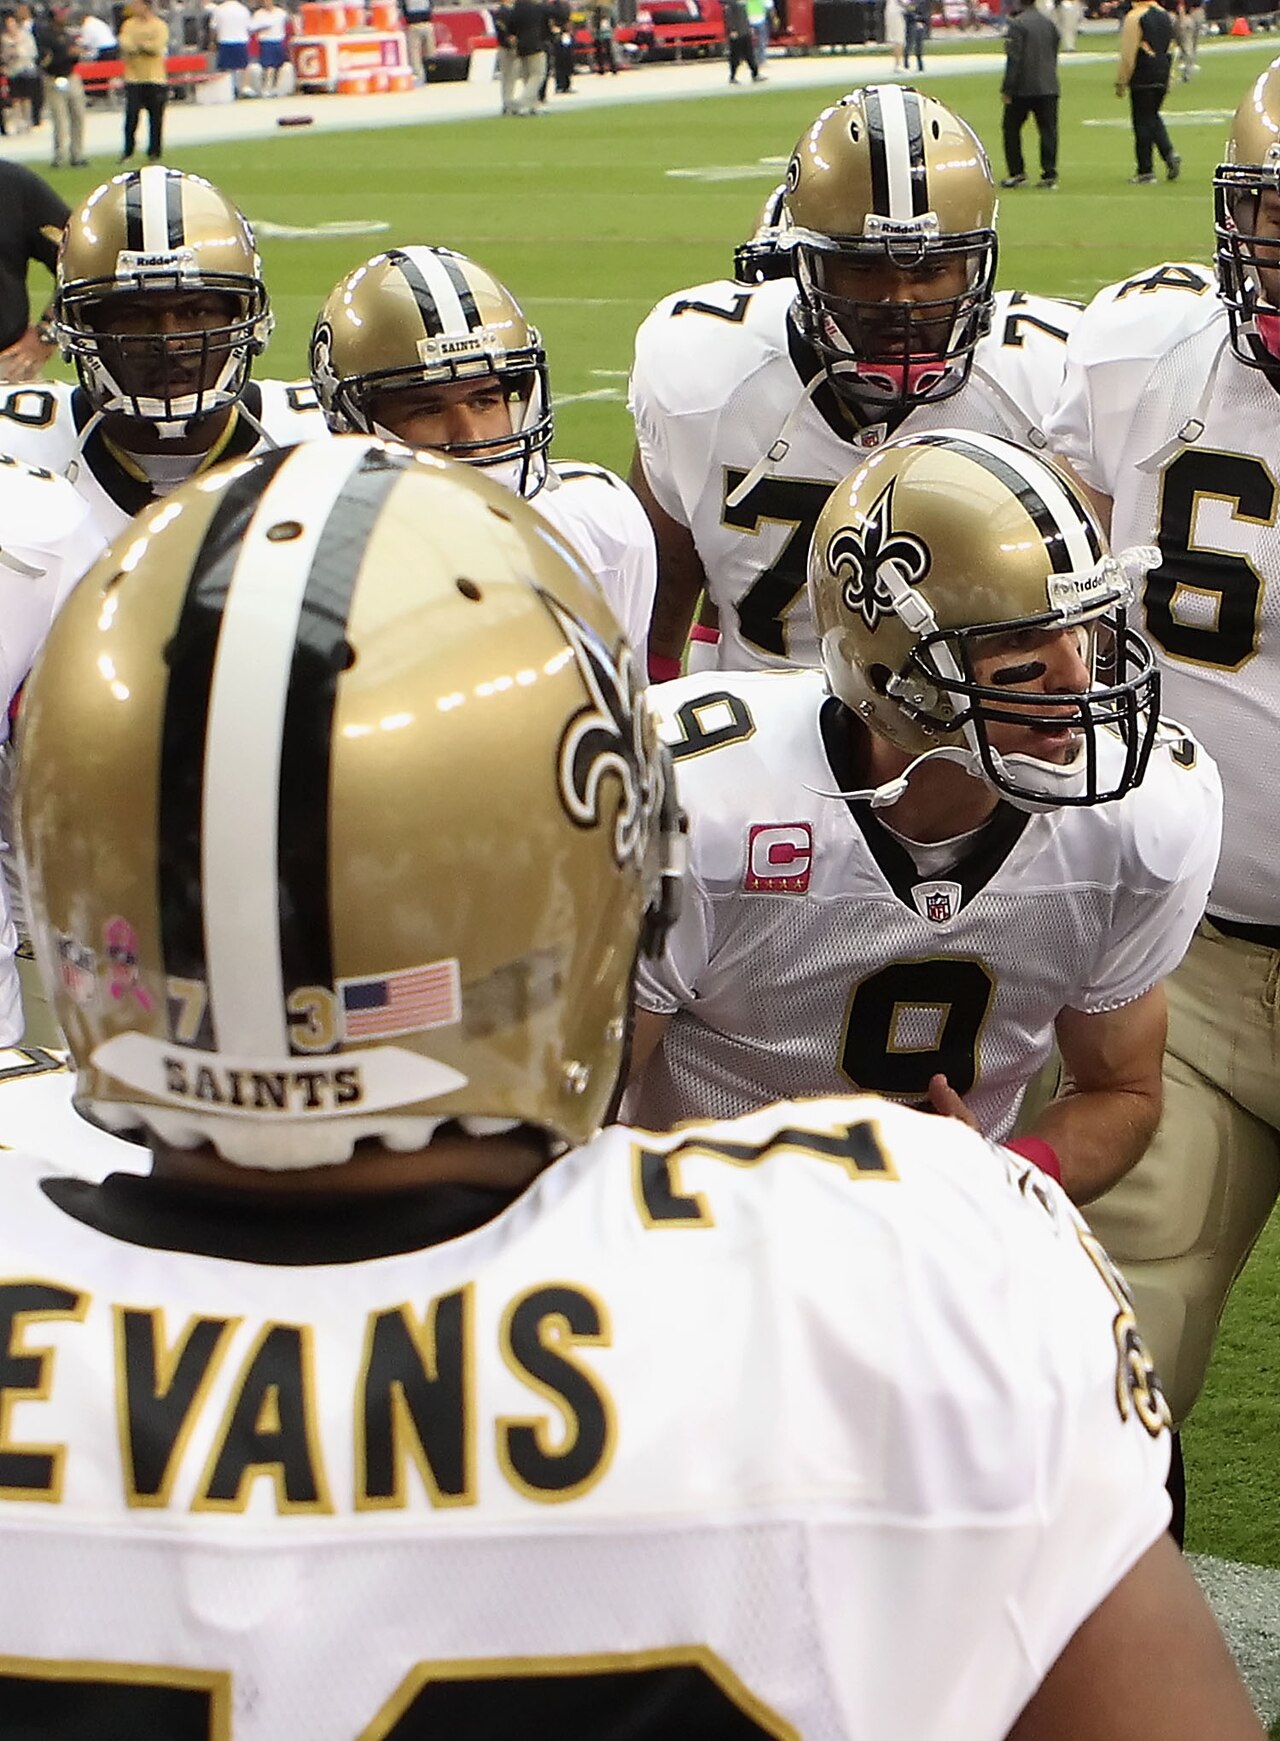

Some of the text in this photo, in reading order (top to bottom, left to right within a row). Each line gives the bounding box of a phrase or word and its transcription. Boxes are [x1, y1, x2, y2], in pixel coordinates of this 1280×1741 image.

[881, 223, 922, 234] Riddell
[440, 340, 481, 354] SAINTS
[751, 827, 810, 878] C
[167, 977, 207, 1043] 7
[288, 986, 338, 1052] 3
[163, 1056, 363, 1108] SAINTS
[0, 1277, 619, 1514] EVANS
